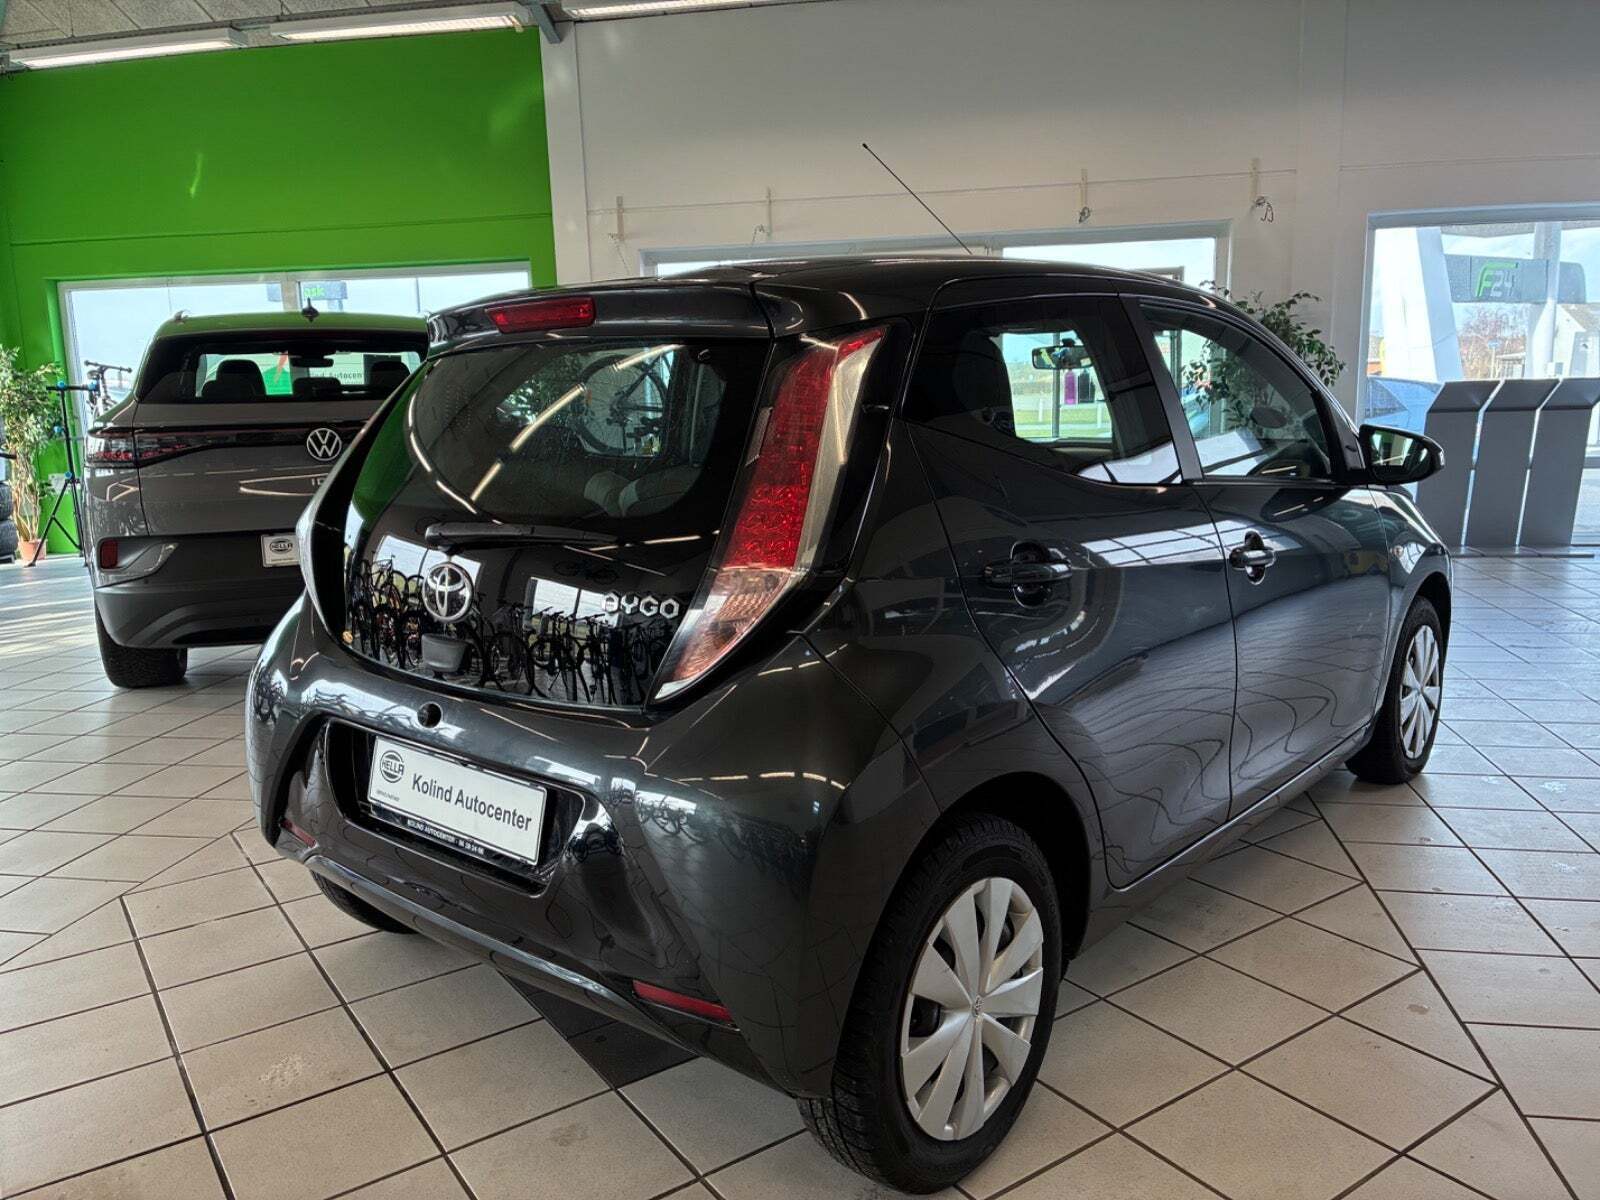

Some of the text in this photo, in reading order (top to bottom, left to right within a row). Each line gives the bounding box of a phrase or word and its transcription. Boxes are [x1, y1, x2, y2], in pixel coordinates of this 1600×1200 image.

[381, 757, 405, 776] HELLA
[412, 773, 532, 831] Kolind Autocenter
